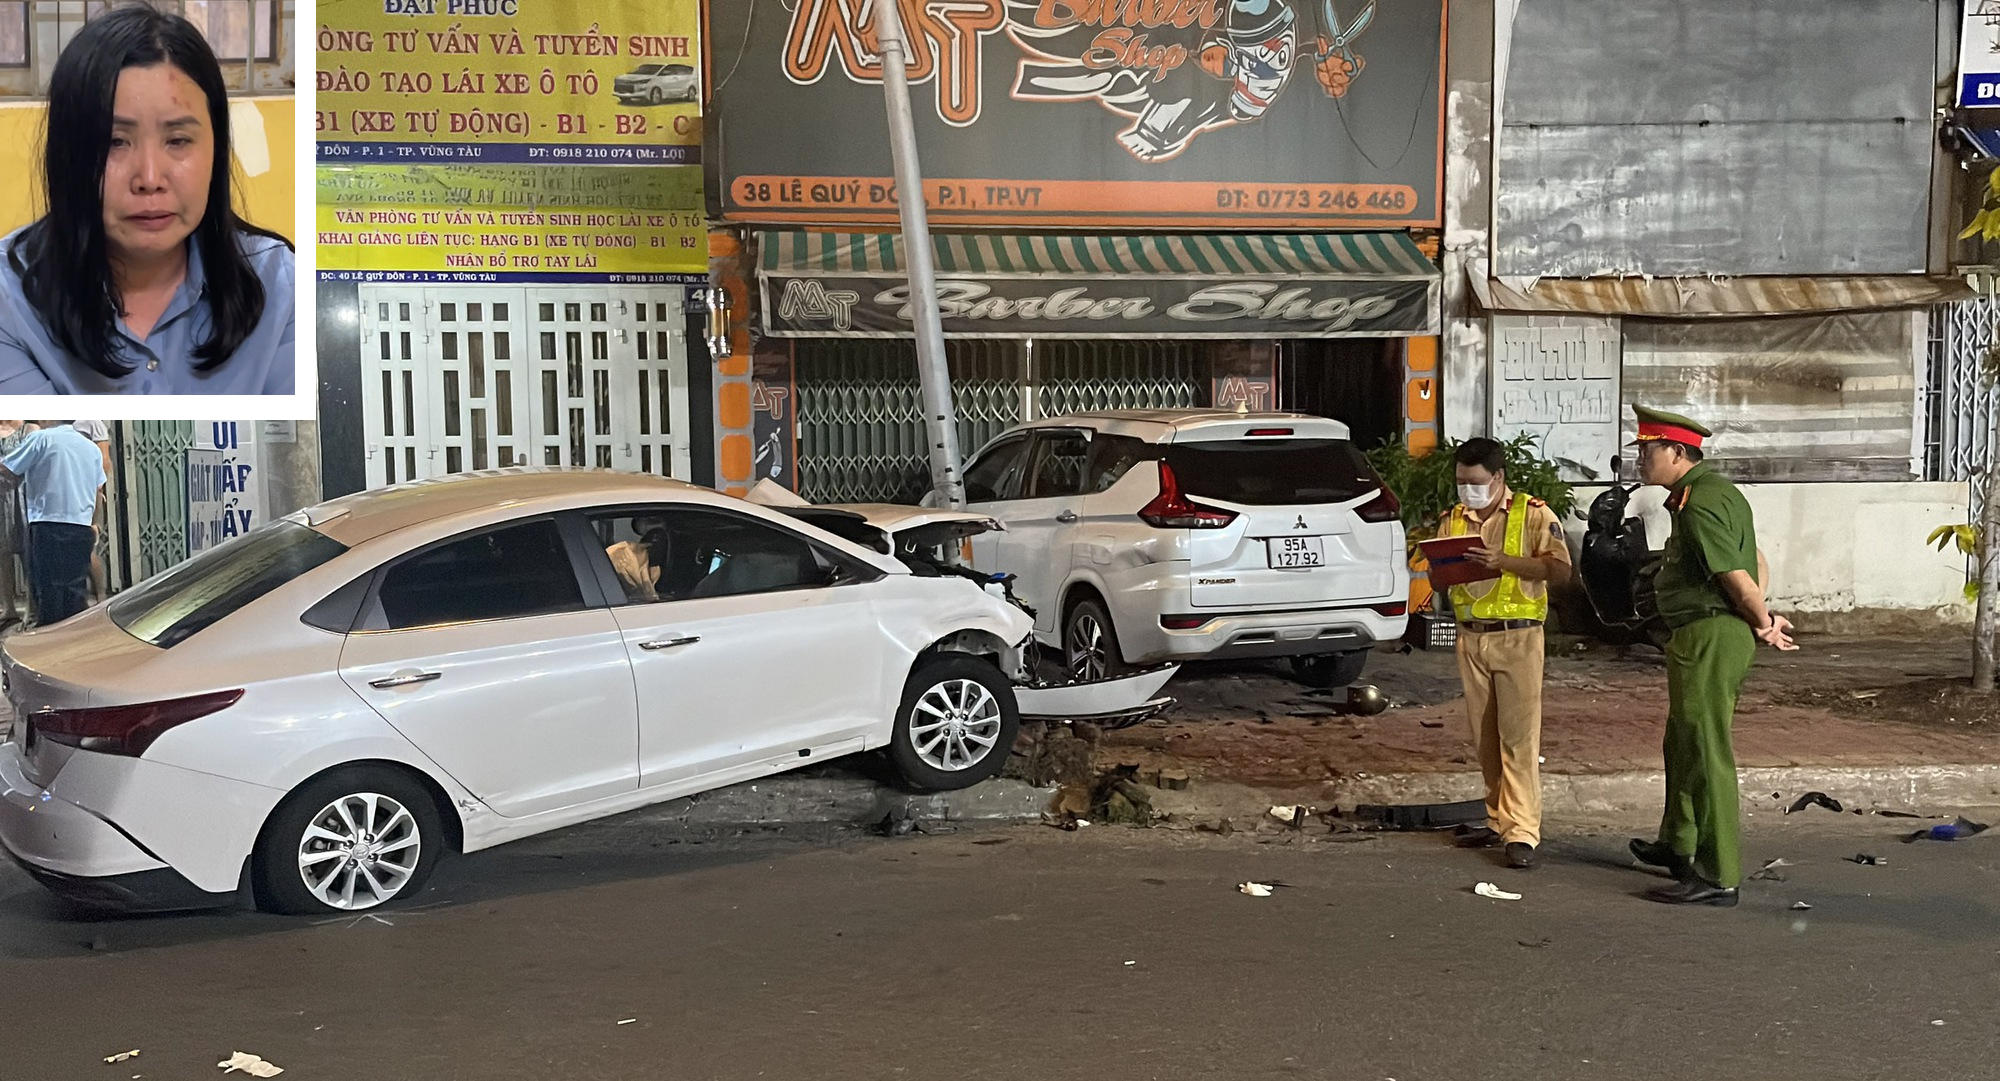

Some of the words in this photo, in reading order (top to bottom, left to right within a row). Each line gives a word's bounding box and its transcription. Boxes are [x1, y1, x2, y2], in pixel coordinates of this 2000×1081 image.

[316, 24, 374, 52] ÒNG
[383, 28, 419, 52] TƯ
[426, 23, 480, 54] VẤN
[489, 28, 525, 55] VÀ
[534, 22, 618, 56] TUYỂN
[629, 36, 690, 57] SINH
[1081, 27, 1188, 83] Shop
[316, 65, 371, 92] ĐÀO
[380, 72, 432, 97] TẠO
[442, 67, 485, 93] LÁI
[494, 73, 530, 94] XE
[539, 68, 555, 95] Ô
[566, 69, 599, 95] TÔ
[352, 109, 395, 135] (XE
[405, 108, 440, 138] TỰ
[449, 107, 530, 138] ĐỘNG)
[557, 114, 588, 134] B1
[615, 114, 647, 135] B2
[673, 115, 690, 135] C
[378, 146, 384, 156] 1
[396, 146, 416, 157] TP.
[420, 144, 454, 157] VŨNG
[457, 144, 482, 157] TÀU
[529, 148, 549, 158] ĐT:
[553, 147, 582, 158] 0918
[585, 148, 608, 158] 210
[611, 148, 633, 159] 074
[743, 183, 772, 202] 38
[780, 178, 802, 202] LÊ
[811, 179, 861, 204] QUÝ
[984, 186, 1042, 207] TP.VT
[1216, 189, 1248, 208] ĐT:
[1257, 190, 1310, 208] 0773
[1318, 190, 1359, 209] 246
[1366, 191, 1406, 209] 468
[335, 209, 364, 224] VĂN
[370, 209, 417, 224] PHÒNG
[422, 211, 440, 224] TƯ
[444, 208, 472, 225] VẤN
[477, 211, 496, 225] VÀ
[500, 209, 545, 226] TUYỂN
[549, 214, 582, 226] SINH
[587, 214, 615, 228] HỌC
[647, 215, 665, 227] XE
[318, 232, 353, 244] KHAI
[358, 229, 402, 245] GIẢNG
[407, 231, 439, 245] LIÊN
[444, 233, 475, 248] TỤC:
[480, 234, 519, 248] HẠNG
[523, 235, 540, 246] B1
[545, 234, 568, 249] (XE
[572, 234, 590, 248] TỰ
[650, 236, 667, 248] B1
[680, 236, 697, 248] B2
[446, 253, 484, 268] NHẬN
[544, 256, 571, 268] TAY
[338, 272, 350, 280] 40
[351, 271, 364, 280] LÊ
[366, 271, 385, 281] QUÝ
[386, 271, 405, 280] ĐÔN
[453, 271, 477, 281] VŨNG
[479, 272, 497, 281] TÀU
[626, 274, 646, 282] 0918
[649, 274, 664, 282] 210
[666, 274, 682, 282] 074
[873, 279, 1155, 320] Barber
[1166, 281, 1397, 332] Shop
[223, 456, 252, 492] ẤP
[223, 498, 252, 537] ẨY
[1277, 552, 1319, 566] 127.92
[1284, 538, 1308, 551] 95A
